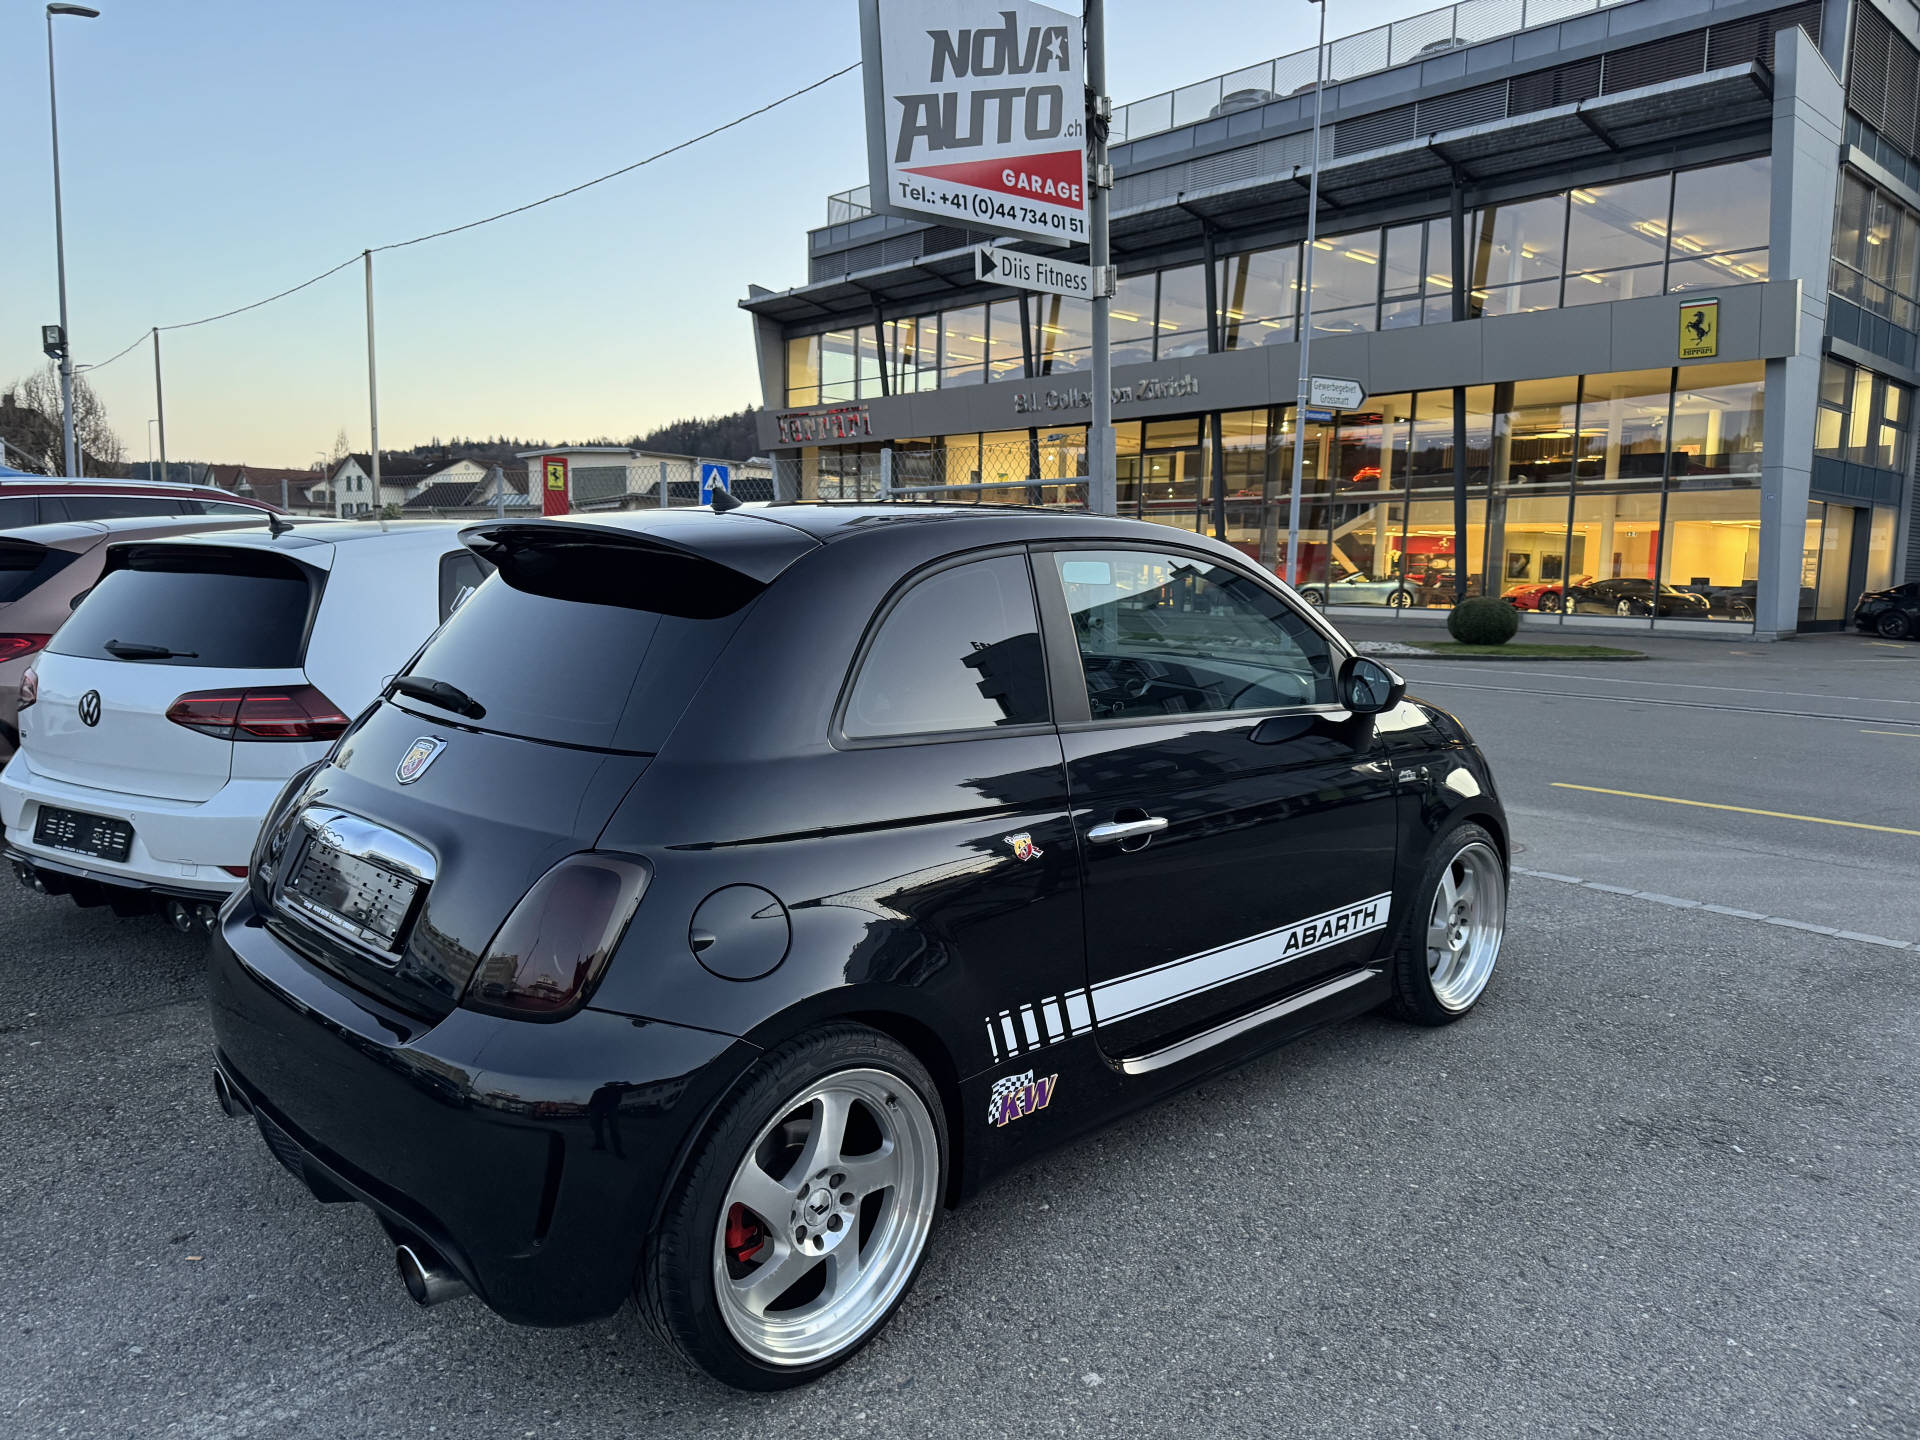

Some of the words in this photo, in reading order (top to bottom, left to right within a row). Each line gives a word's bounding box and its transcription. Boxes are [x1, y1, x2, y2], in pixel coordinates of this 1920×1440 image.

[926, 10, 1071, 83] NOVA
[893, 85, 1063, 163] AUTO
[899, 182, 936, 204] Tel.:
[940, 193, 967, 211] +41
[1020, 207, 1048, 227] 734
[1051, 214, 1066, 230] 01
[1070, 218, 1084, 234] 51
[1002, 168, 1080, 202] GARAGE
[1002, 256, 1030, 281] Diis
[1036, 263, 1087, 291] Fitness
[1136, 374, 1199, 401] Zürich
[776, 404, 873, 444] Ferrari
[1282, 903, 1378, 954] ABARTH
[997, 1073, 1058, 1127] KW
